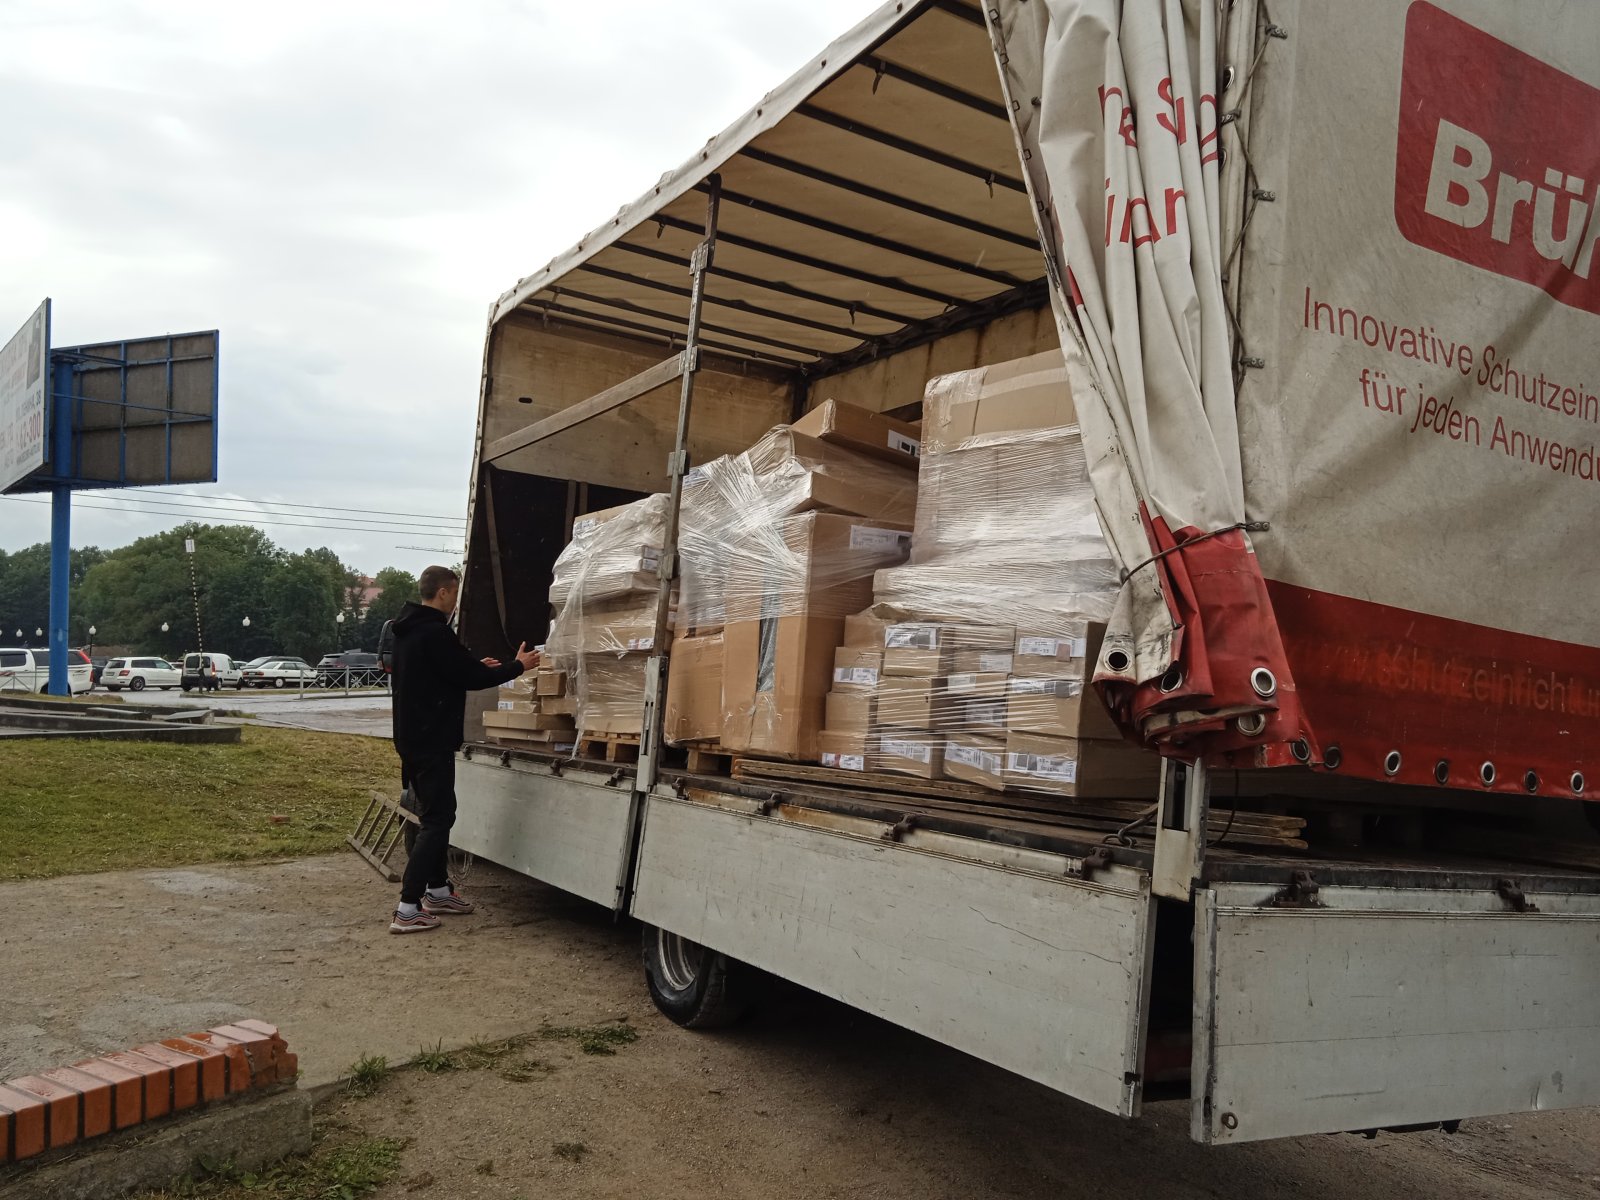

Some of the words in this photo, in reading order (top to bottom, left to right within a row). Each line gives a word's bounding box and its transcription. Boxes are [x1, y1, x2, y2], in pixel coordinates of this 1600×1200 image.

[1303, 286, 1473, 376] Innovative
[1477, 345, 1599, 424] Schutzein
[1359, 368, 1407, 415] für
[1410, 383, 1480, 446] jeden
